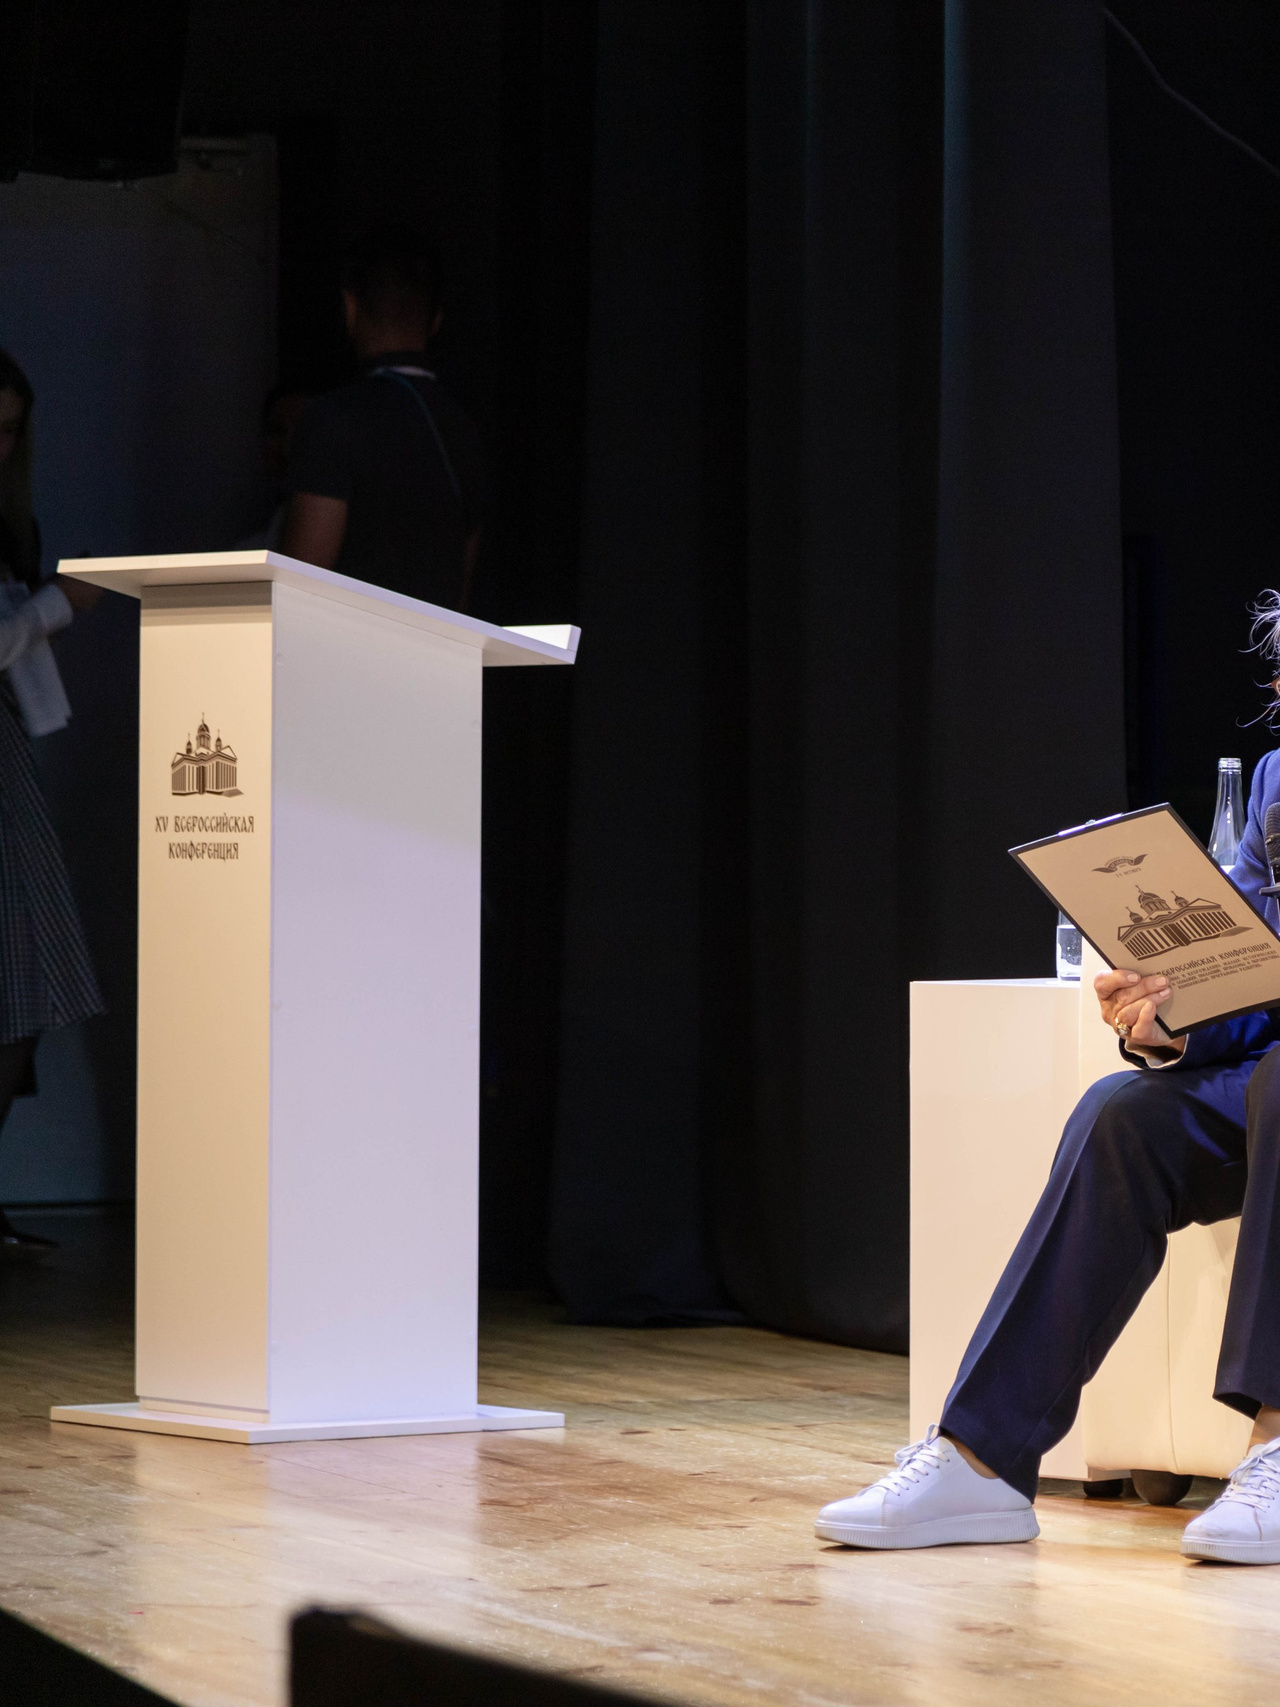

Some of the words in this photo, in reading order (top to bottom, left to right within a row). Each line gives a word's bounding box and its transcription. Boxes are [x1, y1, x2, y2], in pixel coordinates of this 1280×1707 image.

[155, 816, 168, 832] XV
[174, 812, 254, 833] ВСЕРОССИЙСКАЯ
[168, 840, 239, 862] КОНФЕРЕНЦИЯ
[1156, 955, 1218, 976] СЕРОССИЙСКАЯ
[1218, 942, 1272, 960] КОНФЕРЕНЦИЯ
